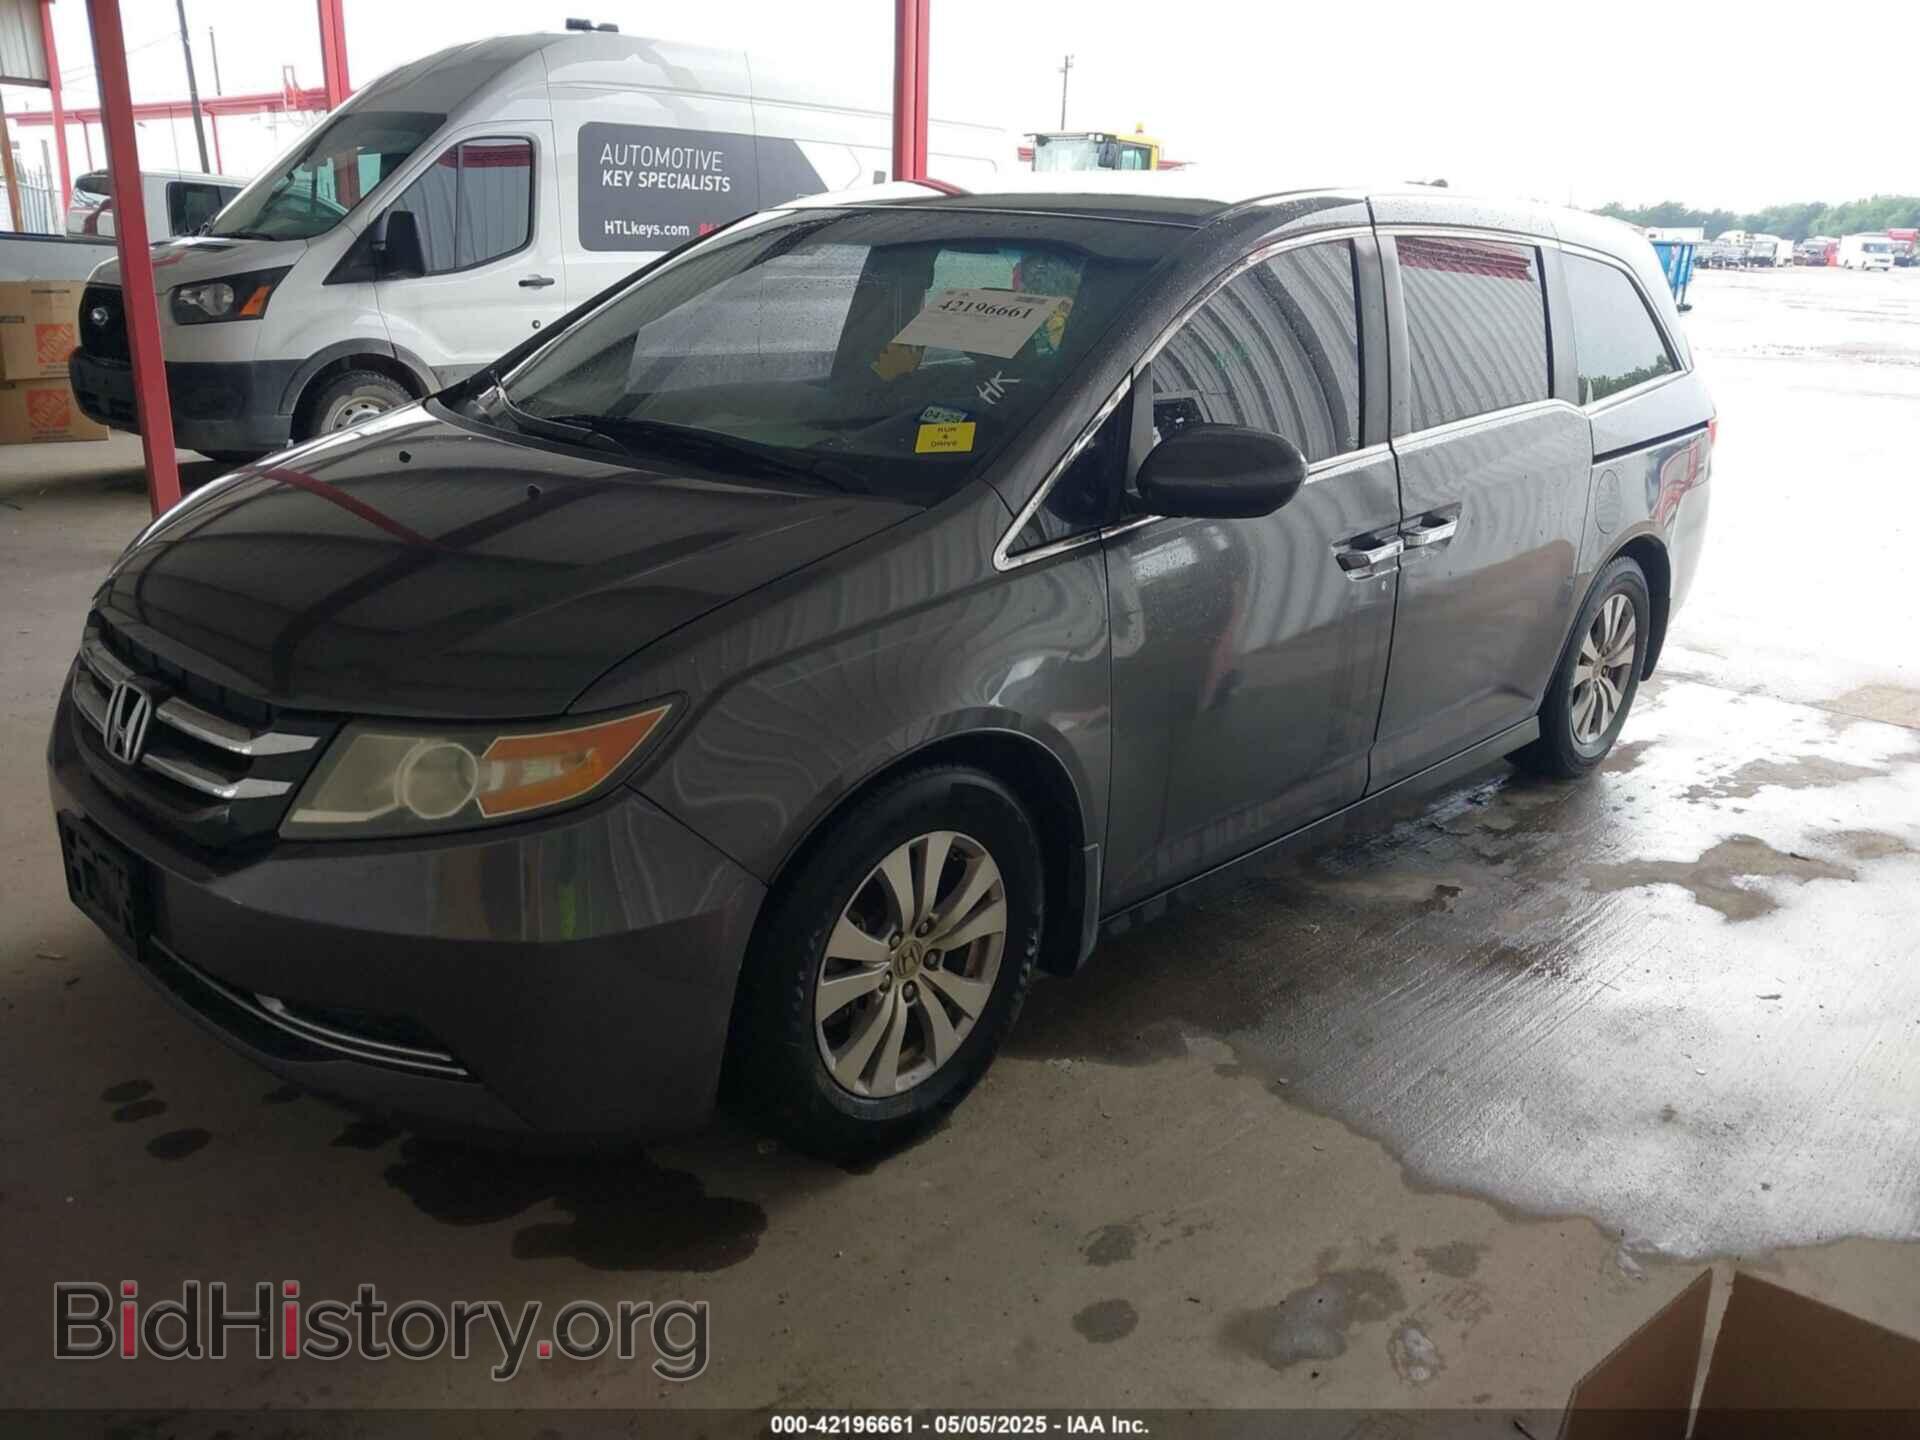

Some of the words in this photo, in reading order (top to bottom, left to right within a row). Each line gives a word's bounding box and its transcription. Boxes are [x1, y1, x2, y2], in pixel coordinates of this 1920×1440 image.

[599, 143, 724, 172] AUTOMOTIVE
[602, 169, 633, 187] KEY
[638, 171, 731, 192] SPECIALISTS
[604, 219, 690, 237] HTLkeys.com
[938, 300, 1033, 319] 42196661
